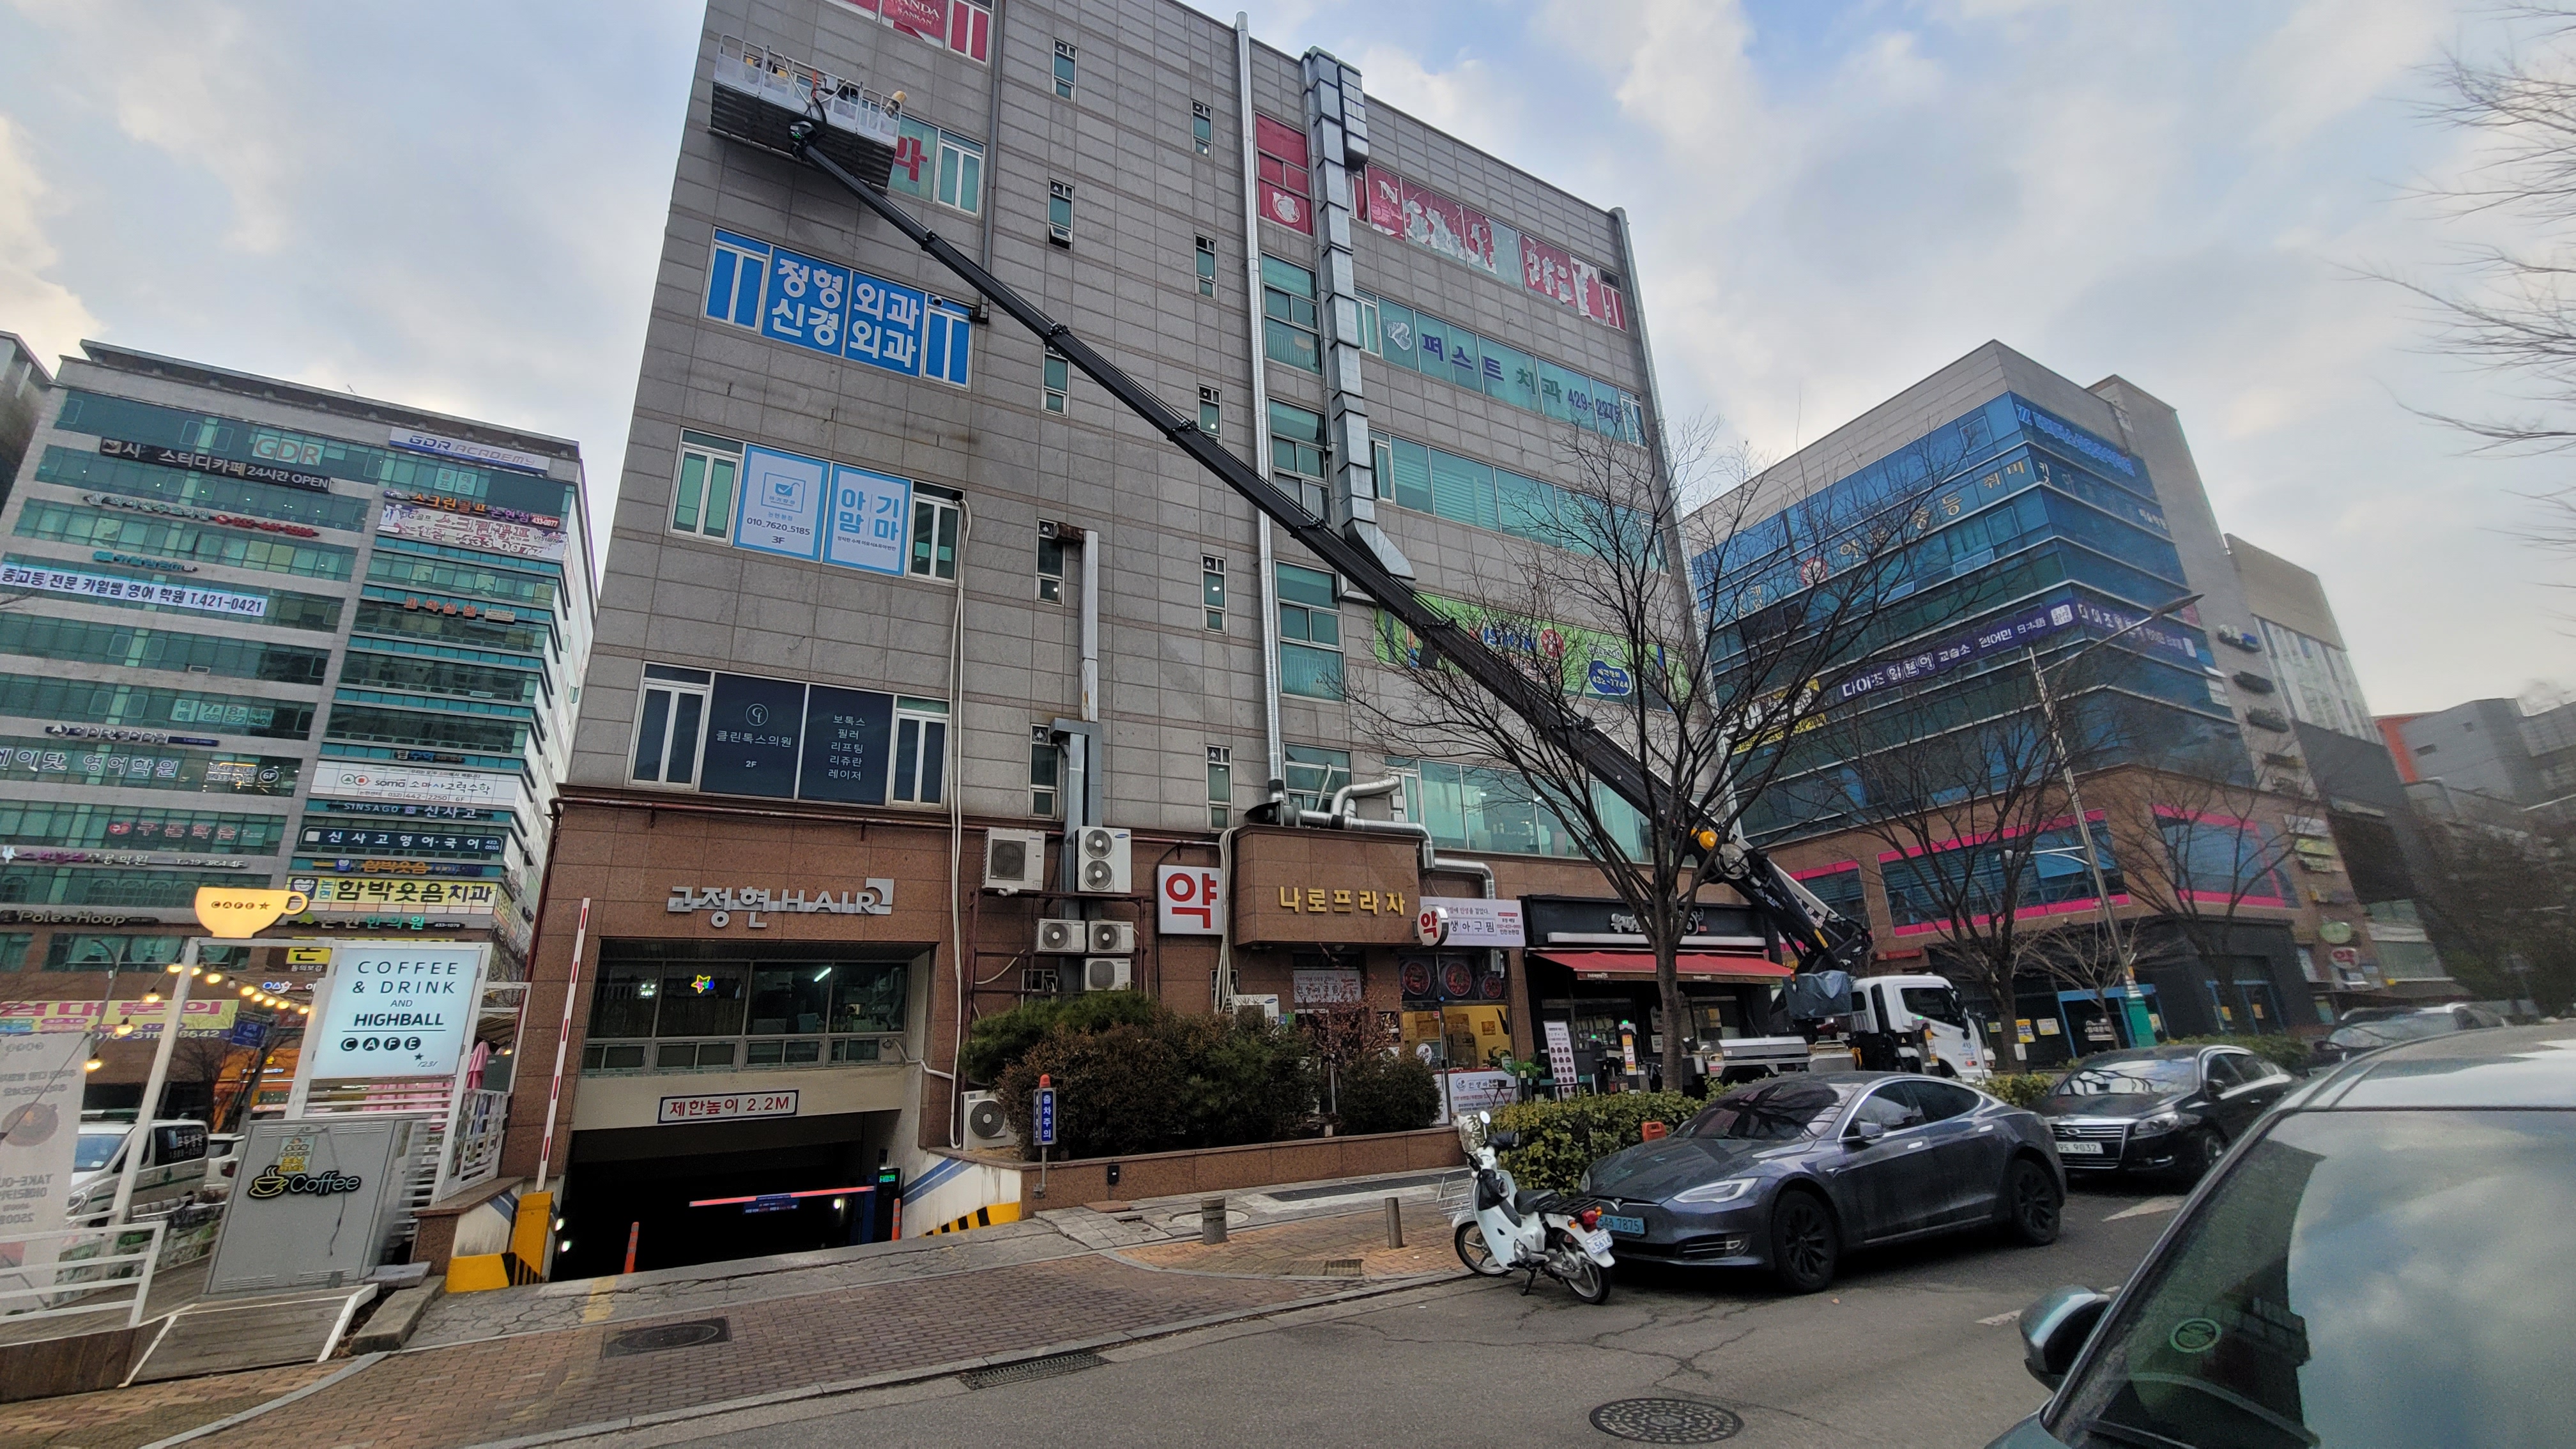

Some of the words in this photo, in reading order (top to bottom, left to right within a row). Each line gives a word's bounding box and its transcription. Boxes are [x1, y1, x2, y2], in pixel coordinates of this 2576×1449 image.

[778, 257, 921, 331] 정형외과
[771, 298, 917, 368] 신경외과
[1421, 332, 1505, 381] 퍼스트
[1517, 367, 1561, 404] 치과
[255, 438, 319, 466] GDR
[409, 435, 451, 450] GDR
[454, 444, 535, 466] ACADEMY
[158, 452, 247, 476] 스터디카페
[247, 466, 290, 481] 24시간
[291, 473, 329, 489] OPEN
[410, 492, 488, 516] 스크린골프
[490, 507, 530, 523] 논현점
[532, 517, 558, 528] 433-0077
[434, 514, 530, 542] 스크린골프
[2, 567, 44, 586] 중고등
[49, 574, 78, 590] 전문
[128, 584, 155, 600] 영어
[159, 588, 187, 604] 학원
[1842, 672, 1885, 698] 다이조
[1937, 644, 1972, 663] 교습소
[832, 714, 866, 727] 보톡스
[716, 730, 793, 749] 클린톡스의원
[836, 728, 860, 740] 필러
[831, 742, 864, 755] 리프팅
[84, 753, 179, 779] 영어학원
[745, 760, 757, 768] 2F
[829, 755, 862, 768] 리쥬란
[828, 768, 862, 781] 레이저
[374, 779, 406, 788] soma
[409, 780, 491, 795] 소마사고력수학
[344, 802, 399, 813] SINSAGO
[424, 805, 478, 818] 신사고
[336, 879, 493, 903] 함박웃음치과
[211, 900, 255, 910] CAFE
[1165, 873, 1218, 930] 약
[1279, 885, 1406, 916] 나로프라자
[18, 910, 62, 923] Pole
[76, 910, 126, 926] Hoop
[1420, 911, 1438, 939] 약
[1450, 920, 1495, 933] 생아구찜
[358, 961, 458, 975] COFFEE
[352, 981, 365, 994] &
[379, 981, 456, 994] DRINK
[390, 999, 413, 1008] AND
[354, 1013, 445, 1027] HIGHBALL
[341, 1036, 422, 1052] CAFE
[669, 1098, 739, 1117] 제한높이
[746, 1096, 790, 1113] 2.2M
[1043, 1094, 1052, 1138] 출차주의
[290, 1172, 360, 1194] Coffee
[1616, 1218, 1640, 1232] 7875
